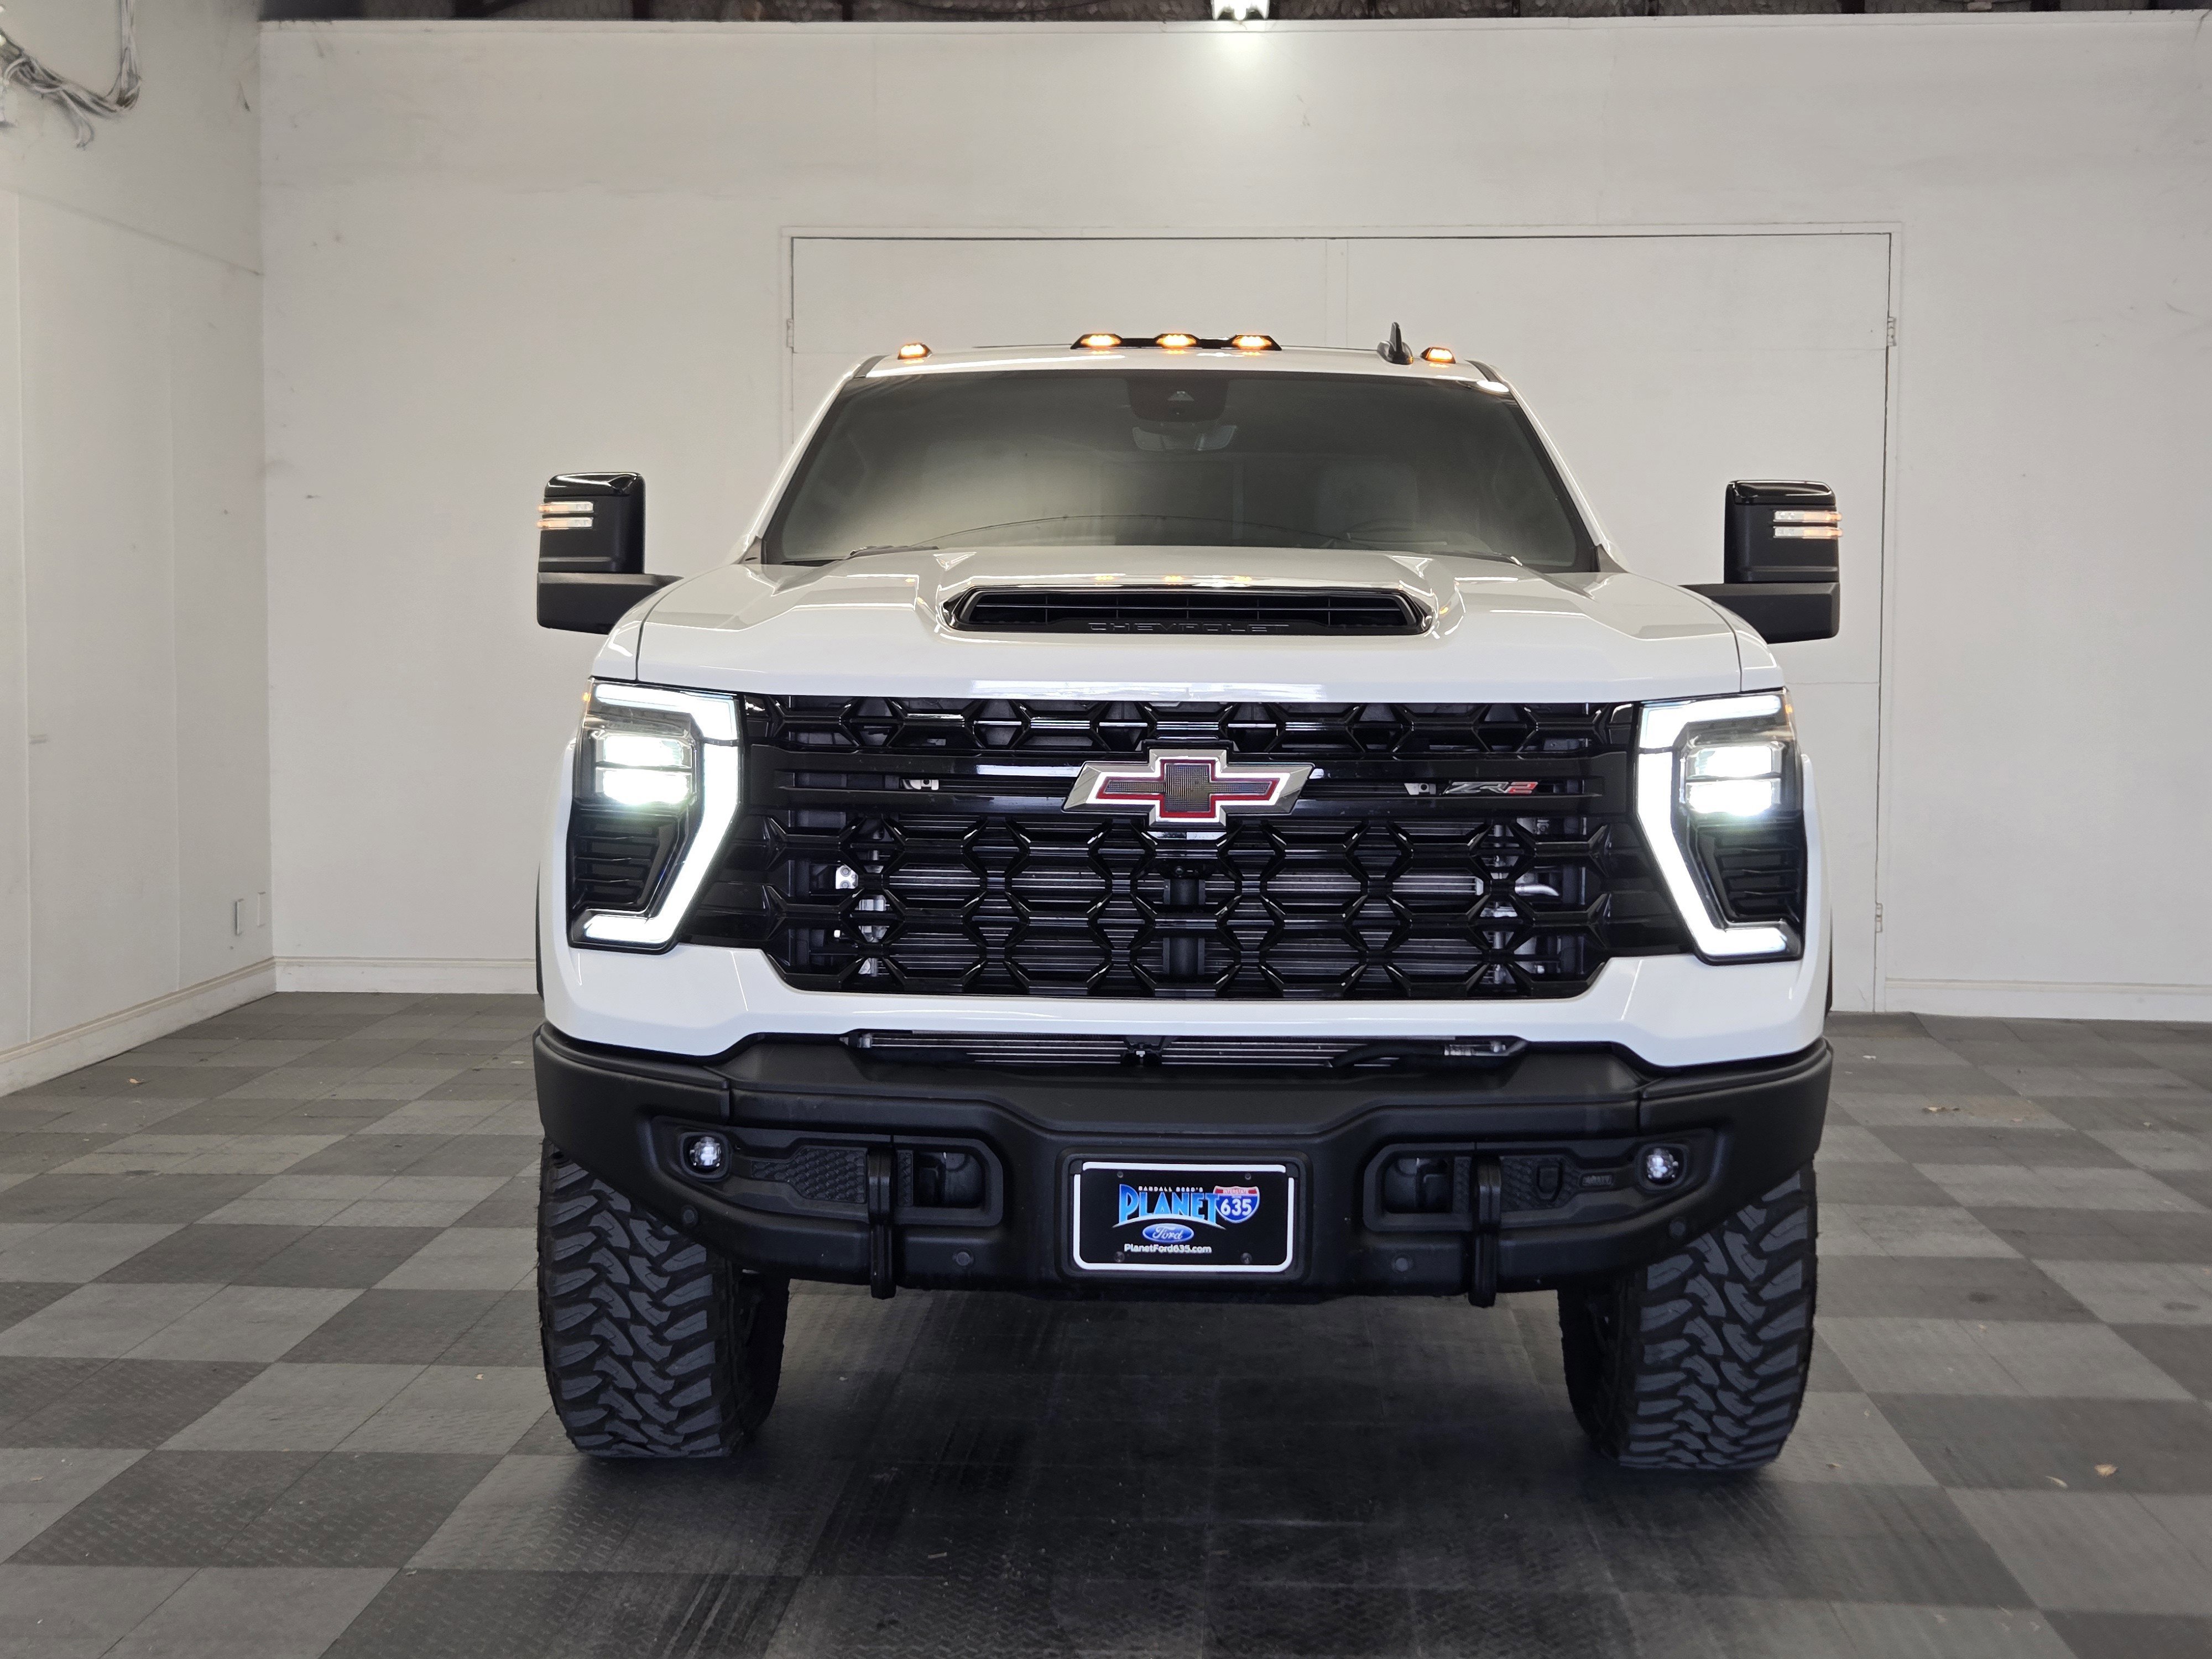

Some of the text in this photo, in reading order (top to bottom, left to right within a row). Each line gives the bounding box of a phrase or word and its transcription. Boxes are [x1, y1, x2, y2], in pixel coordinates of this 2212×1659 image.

[1445, 781, 1538, 794] ZR2
[1119, 1184, 1220, 1225] PLANET
[1220, 1198, 1252, 1216] 635
[1152, 1226, 1183, 1239] Ford
[1124, 1243, 1212, 1253] PlanetFord635.com
